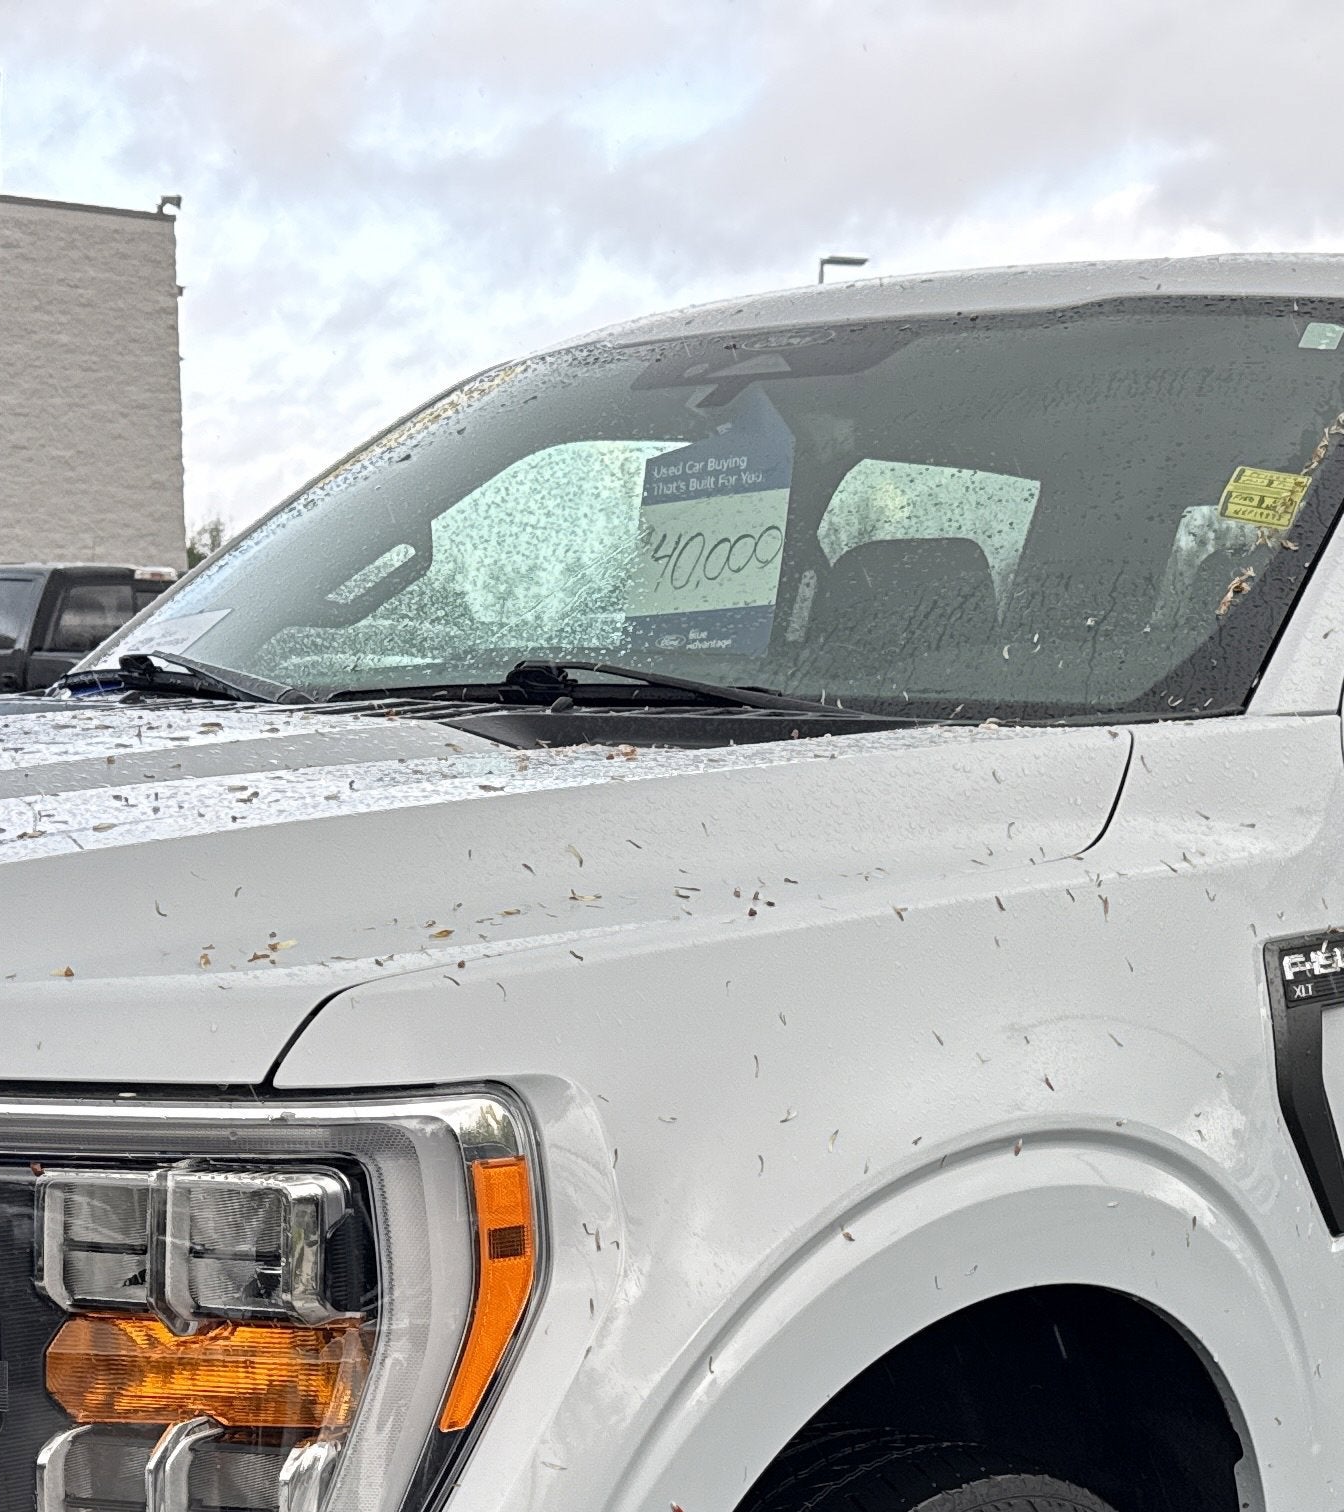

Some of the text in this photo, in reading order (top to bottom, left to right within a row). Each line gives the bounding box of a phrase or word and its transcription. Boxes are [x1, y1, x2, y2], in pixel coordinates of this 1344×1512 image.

[653, 455, 748, 478] Used Car Buying
[652, 480, 686, 496] That's
[689, 475, 715, 491] Built
[718, 473, 738, 488] For
[1292, 983, 1314, 999] XLT
